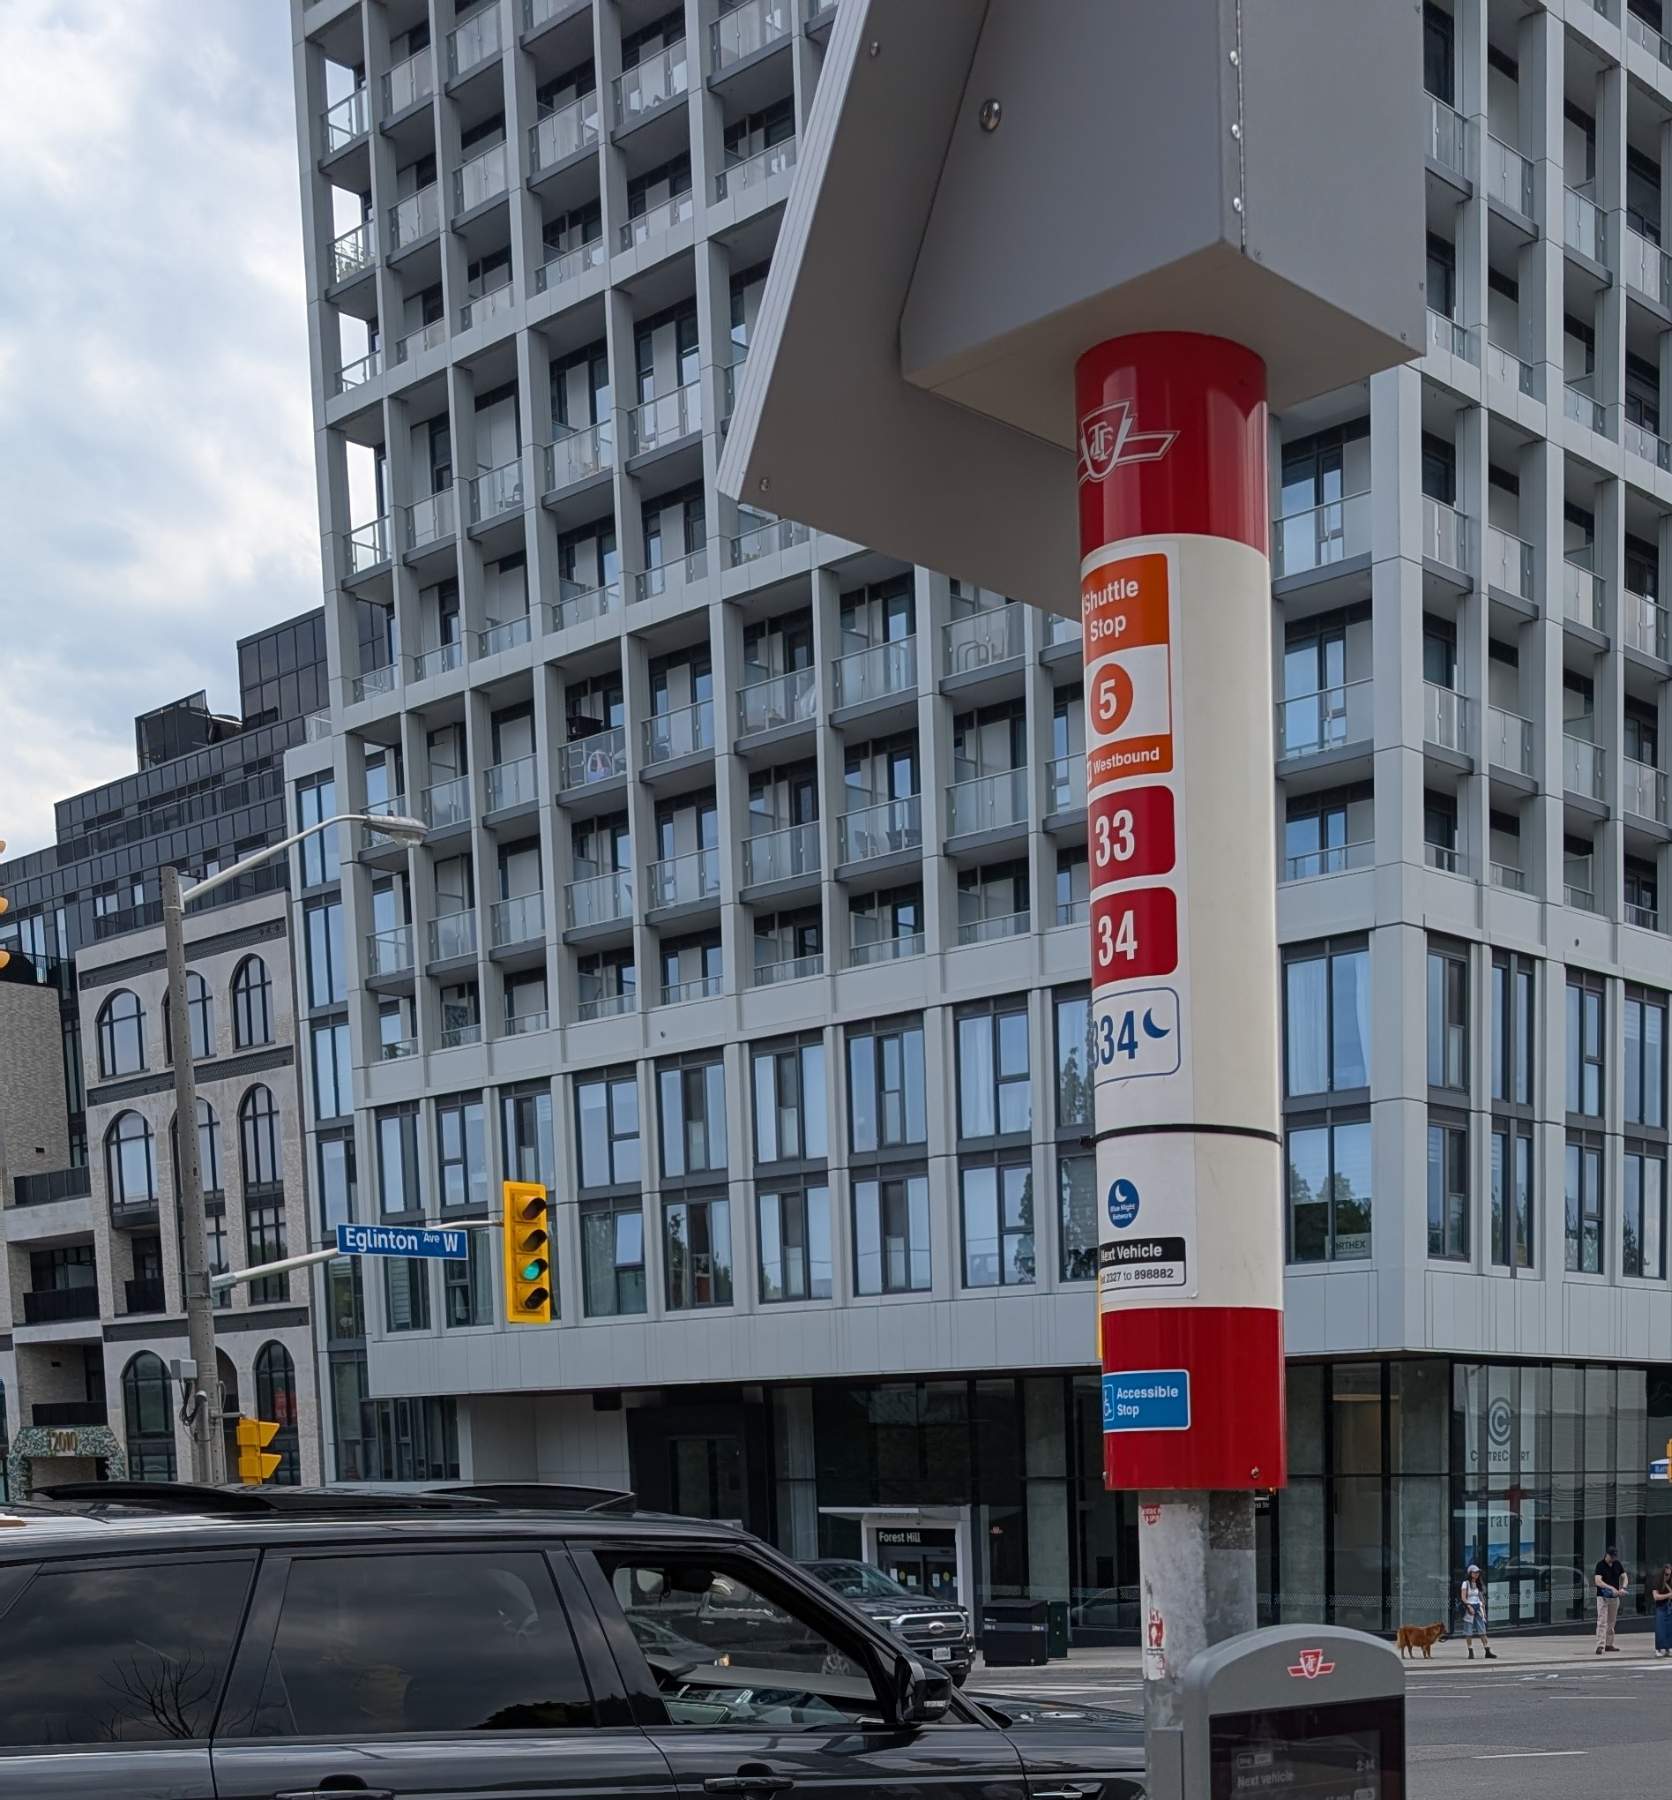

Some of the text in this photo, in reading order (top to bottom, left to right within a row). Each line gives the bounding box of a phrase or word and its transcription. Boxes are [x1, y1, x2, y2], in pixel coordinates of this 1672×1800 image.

[1084, 578, 1138, 615] Shuttle
[1090, 615, 1126, 642] Stop
[1099, 678, 1117, 720] 5
[1093, 747, 1160, 774] Westbound
[1095, 810, 1135, 867] 33
[1098, 910, 1138, 967] 34
[345, 1227, 458, 1252] Eglinton Ave W
[1117, 1243, 1162, 1260] Vehicle
[1123, 1271, 1132, 1281] to
[1134, 1268, 1174, 1280] 898882
[1117, 1385, 1179, 1400] Accessible
[1117, 1404, 1140, 1418] Stop
[879, 1532, 921, 1543] Forest Hill
[1237, 1771, 1294, 1789] Next vehicle
